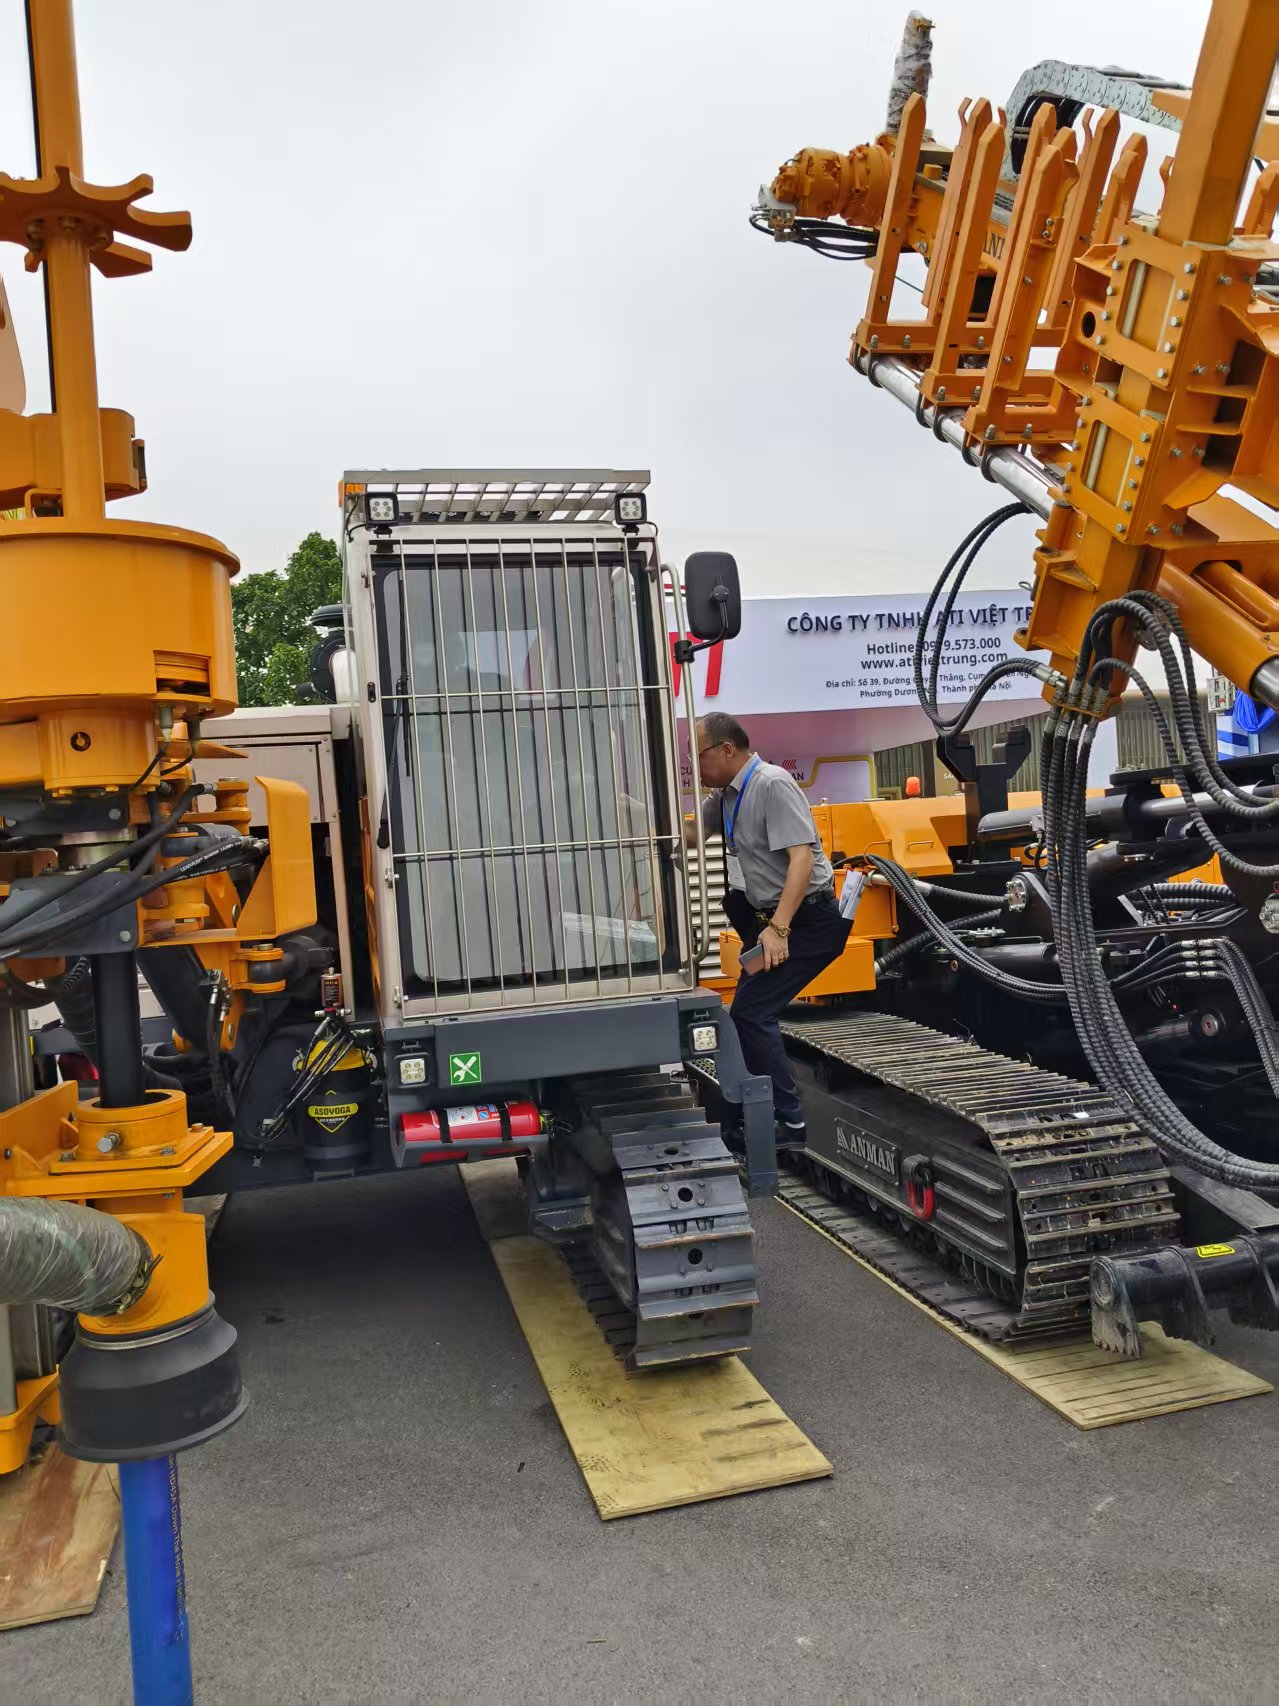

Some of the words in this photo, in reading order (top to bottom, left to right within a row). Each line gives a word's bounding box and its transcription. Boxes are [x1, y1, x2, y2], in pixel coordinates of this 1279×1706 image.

[787, 612, 842, 632] CÔNG
[848, 614, 870, 630] TY
[969, 604, 1008, 626] VIỆT
[922, 637, 1001, 652] 099.573.000
[826, 680, 839, 688] Địa
[841, 678, 856, 687] chỉ:
[858, 677, 868, 686] Số
[883, 676, 911, 686] Đường
[860, 689, 892, 698] Phường
[894, 688, 917, 696] Dươn
[942, 683, 967, 693] Thành
[314, 1106, 351, 1116] ASOYOGA
[850, 1133, 895, 1174] ANMAN
